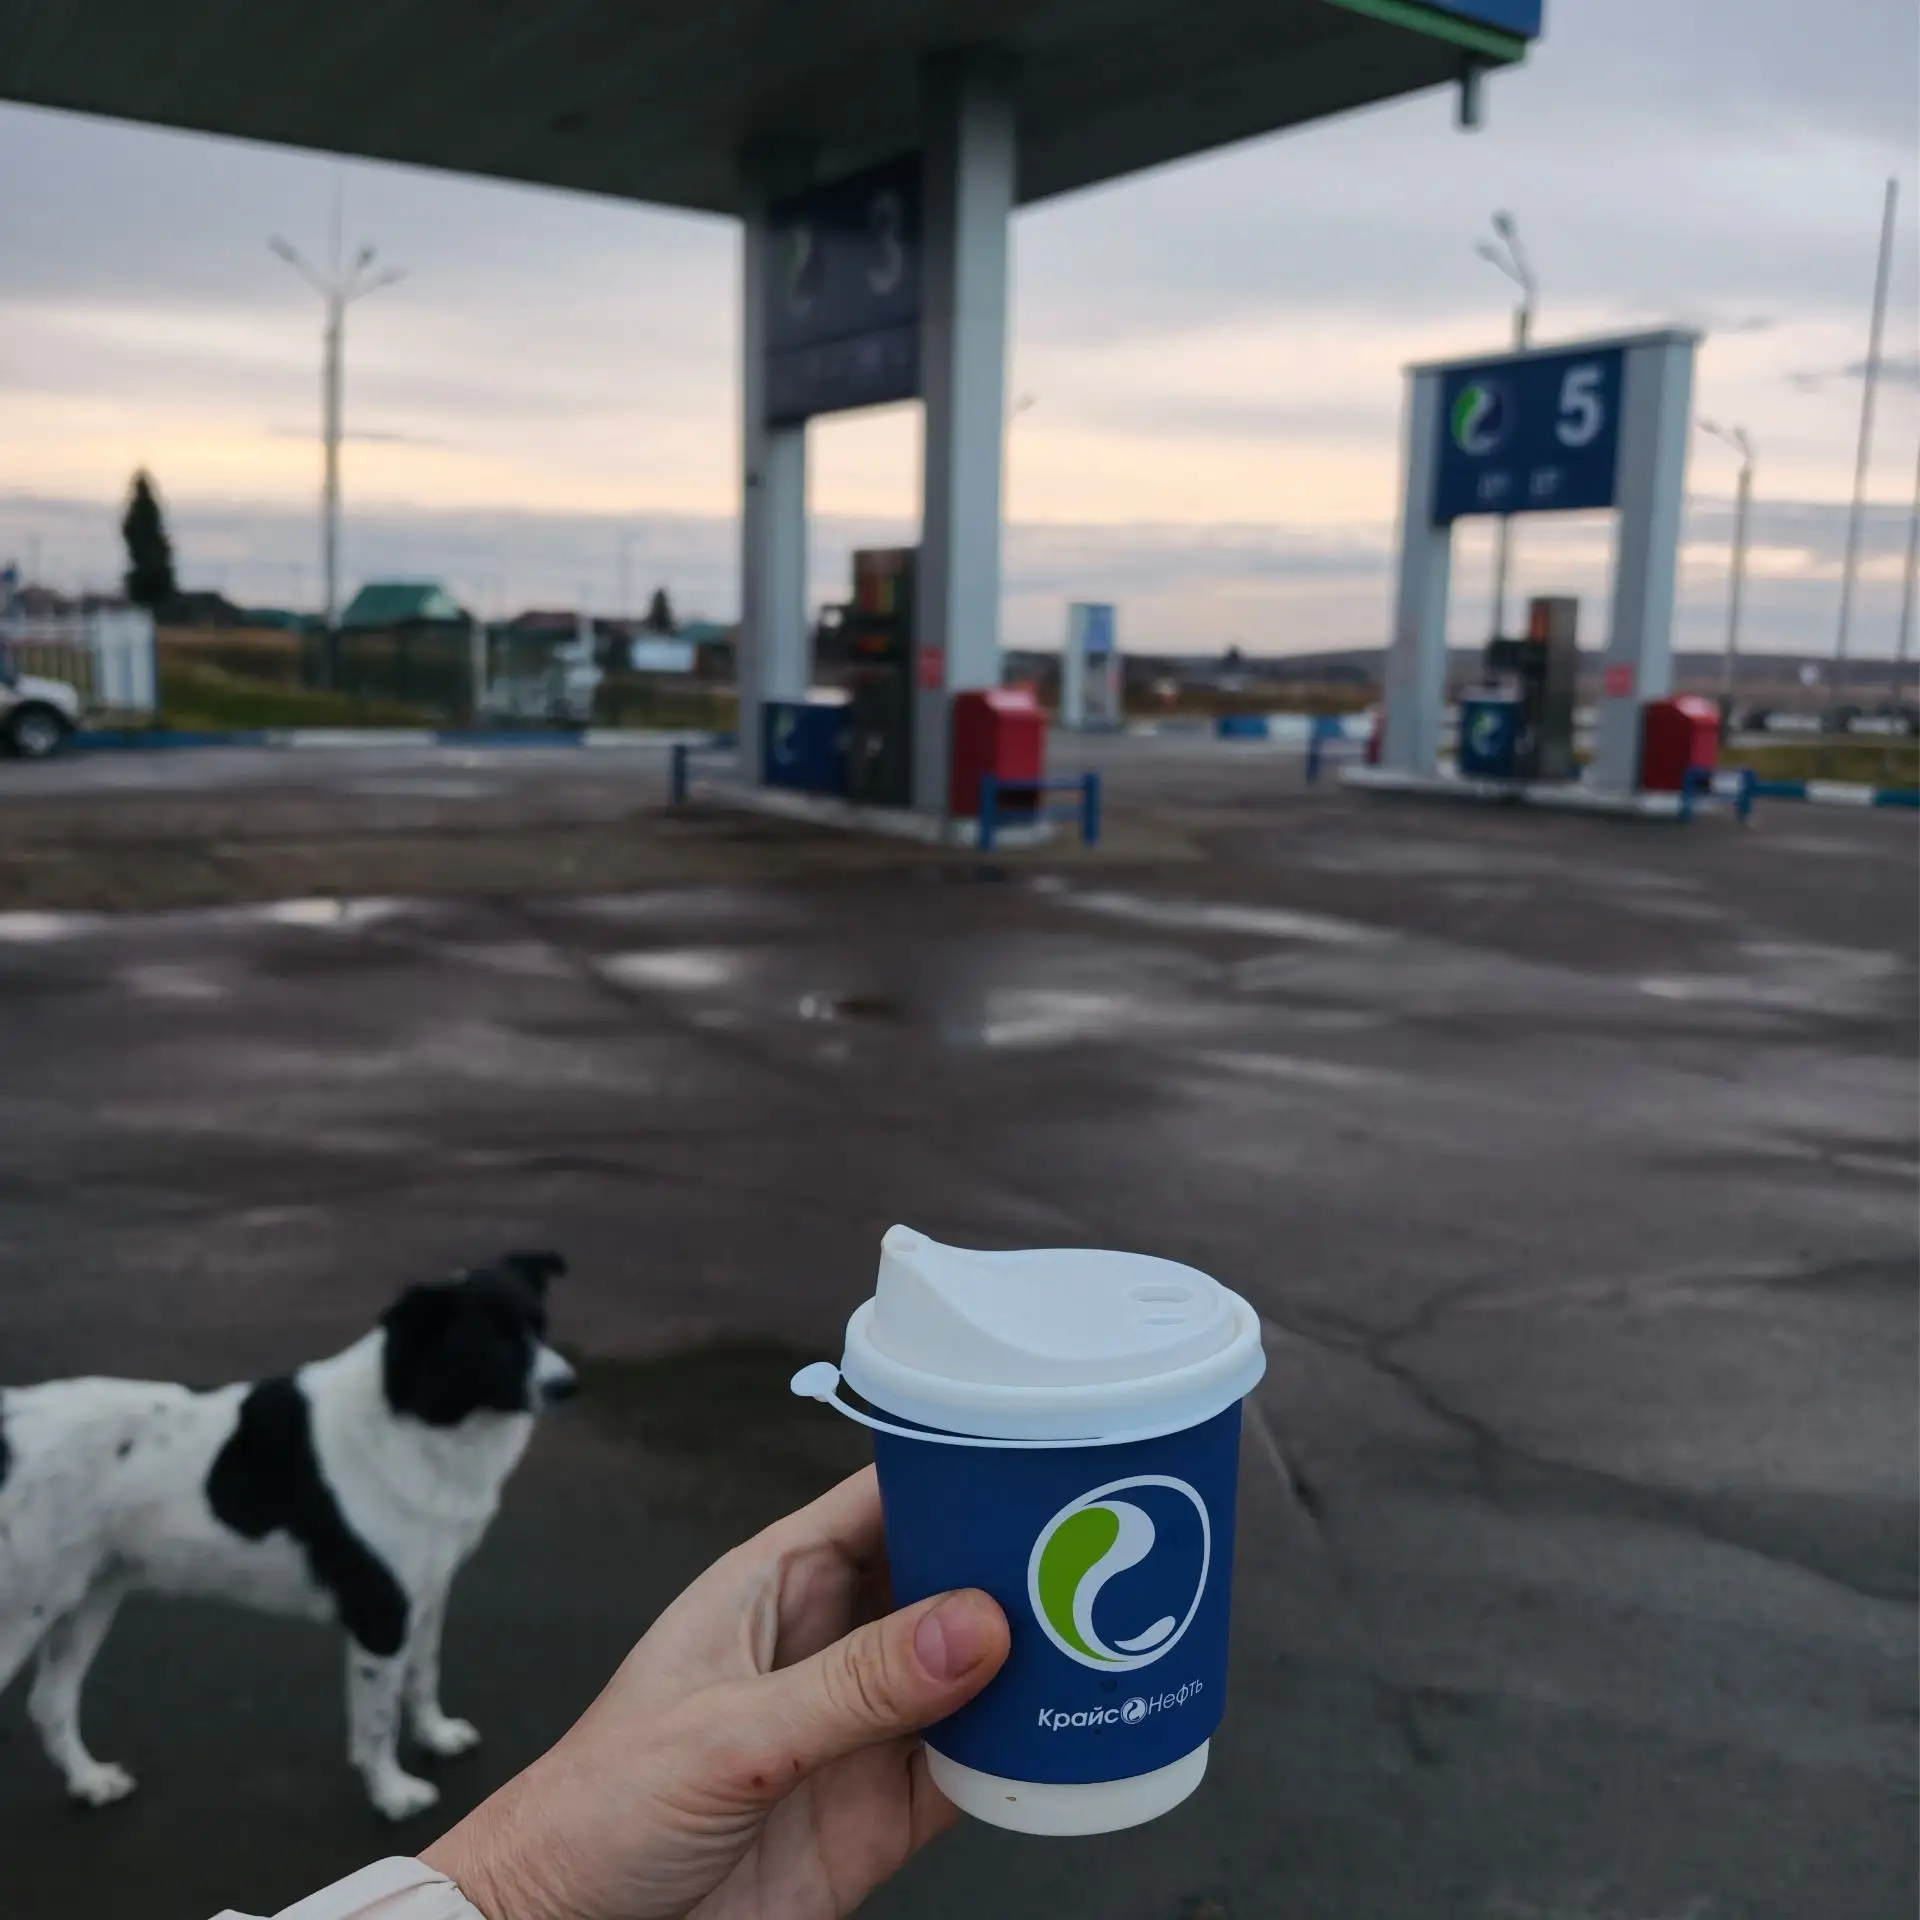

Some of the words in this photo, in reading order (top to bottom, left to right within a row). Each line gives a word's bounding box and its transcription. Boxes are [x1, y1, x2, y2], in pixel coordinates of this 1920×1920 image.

[866, 192, 904, 297] 3
[1555, 363, 1604, 447] 5
[1037, 1706, 1120, 1731] Крайс
[1147, 1679, 1204, 1715] Нефть
